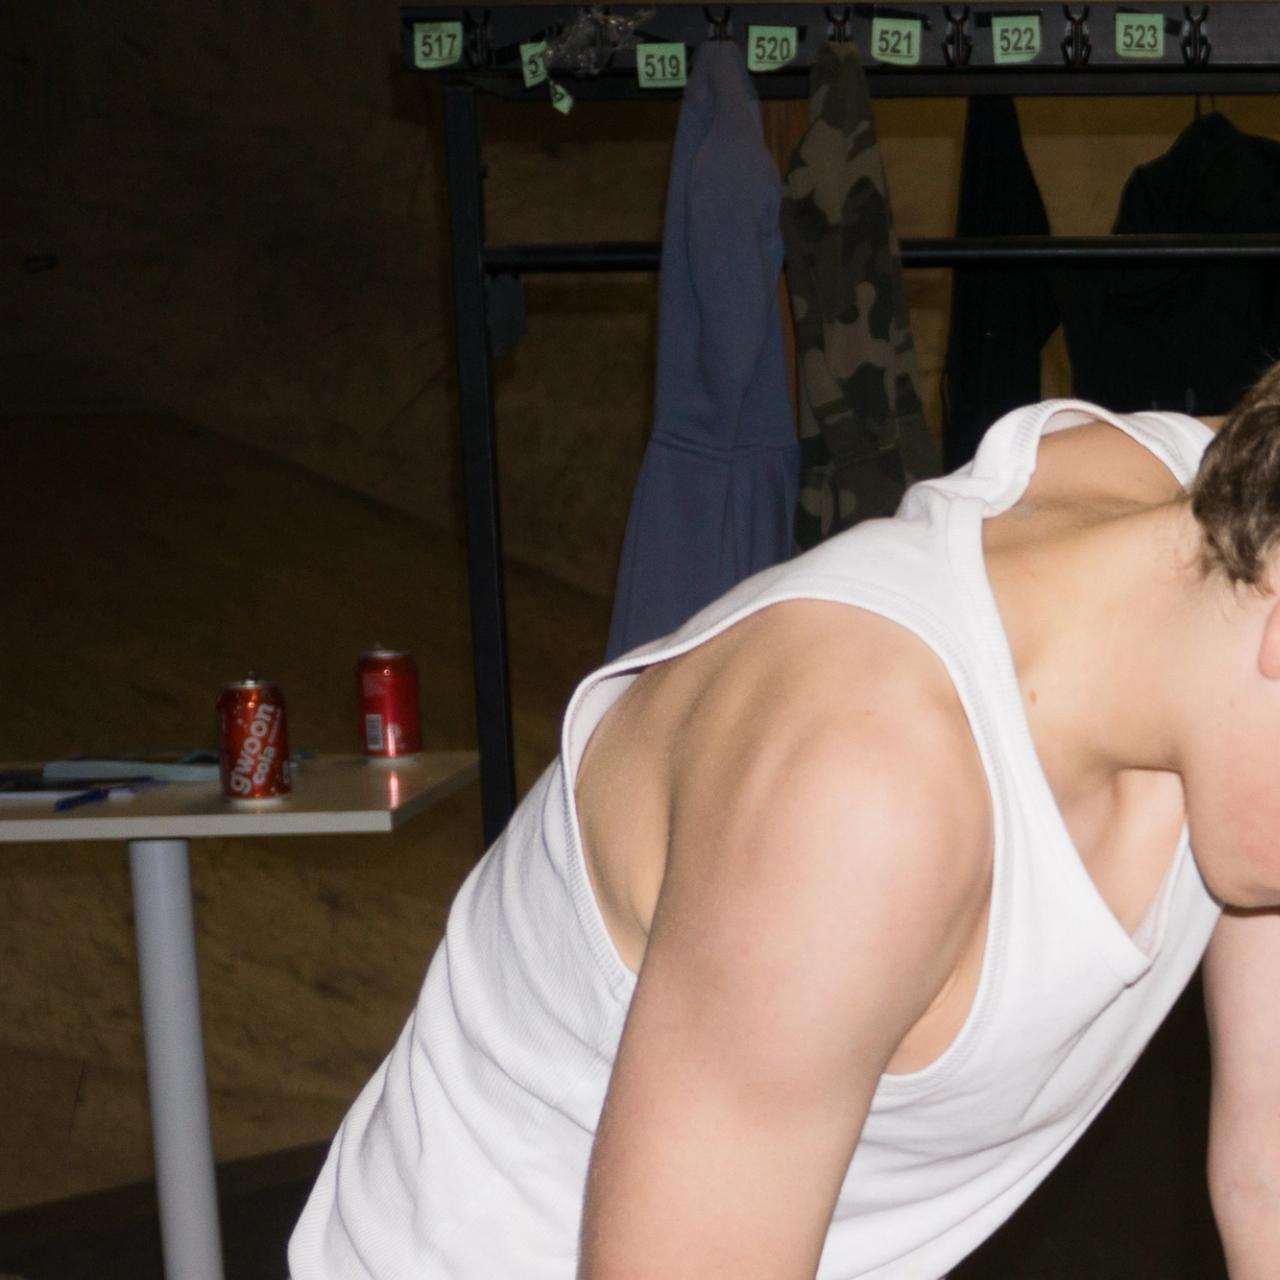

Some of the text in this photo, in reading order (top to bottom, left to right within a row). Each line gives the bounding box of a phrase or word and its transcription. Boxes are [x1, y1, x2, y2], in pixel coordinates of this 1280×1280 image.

[421, 32, 458, 59] 517
[755, 36, 791, 61] 520
[877, 30, 914, 54] 521
[999, 27, 1036, 52] 522
[1122, 25, 1159, 49] 523
[644, 54, 681, 78] 519
[230, 704, 275, 794] gwoon
[253, 746, 276, 784] cola
